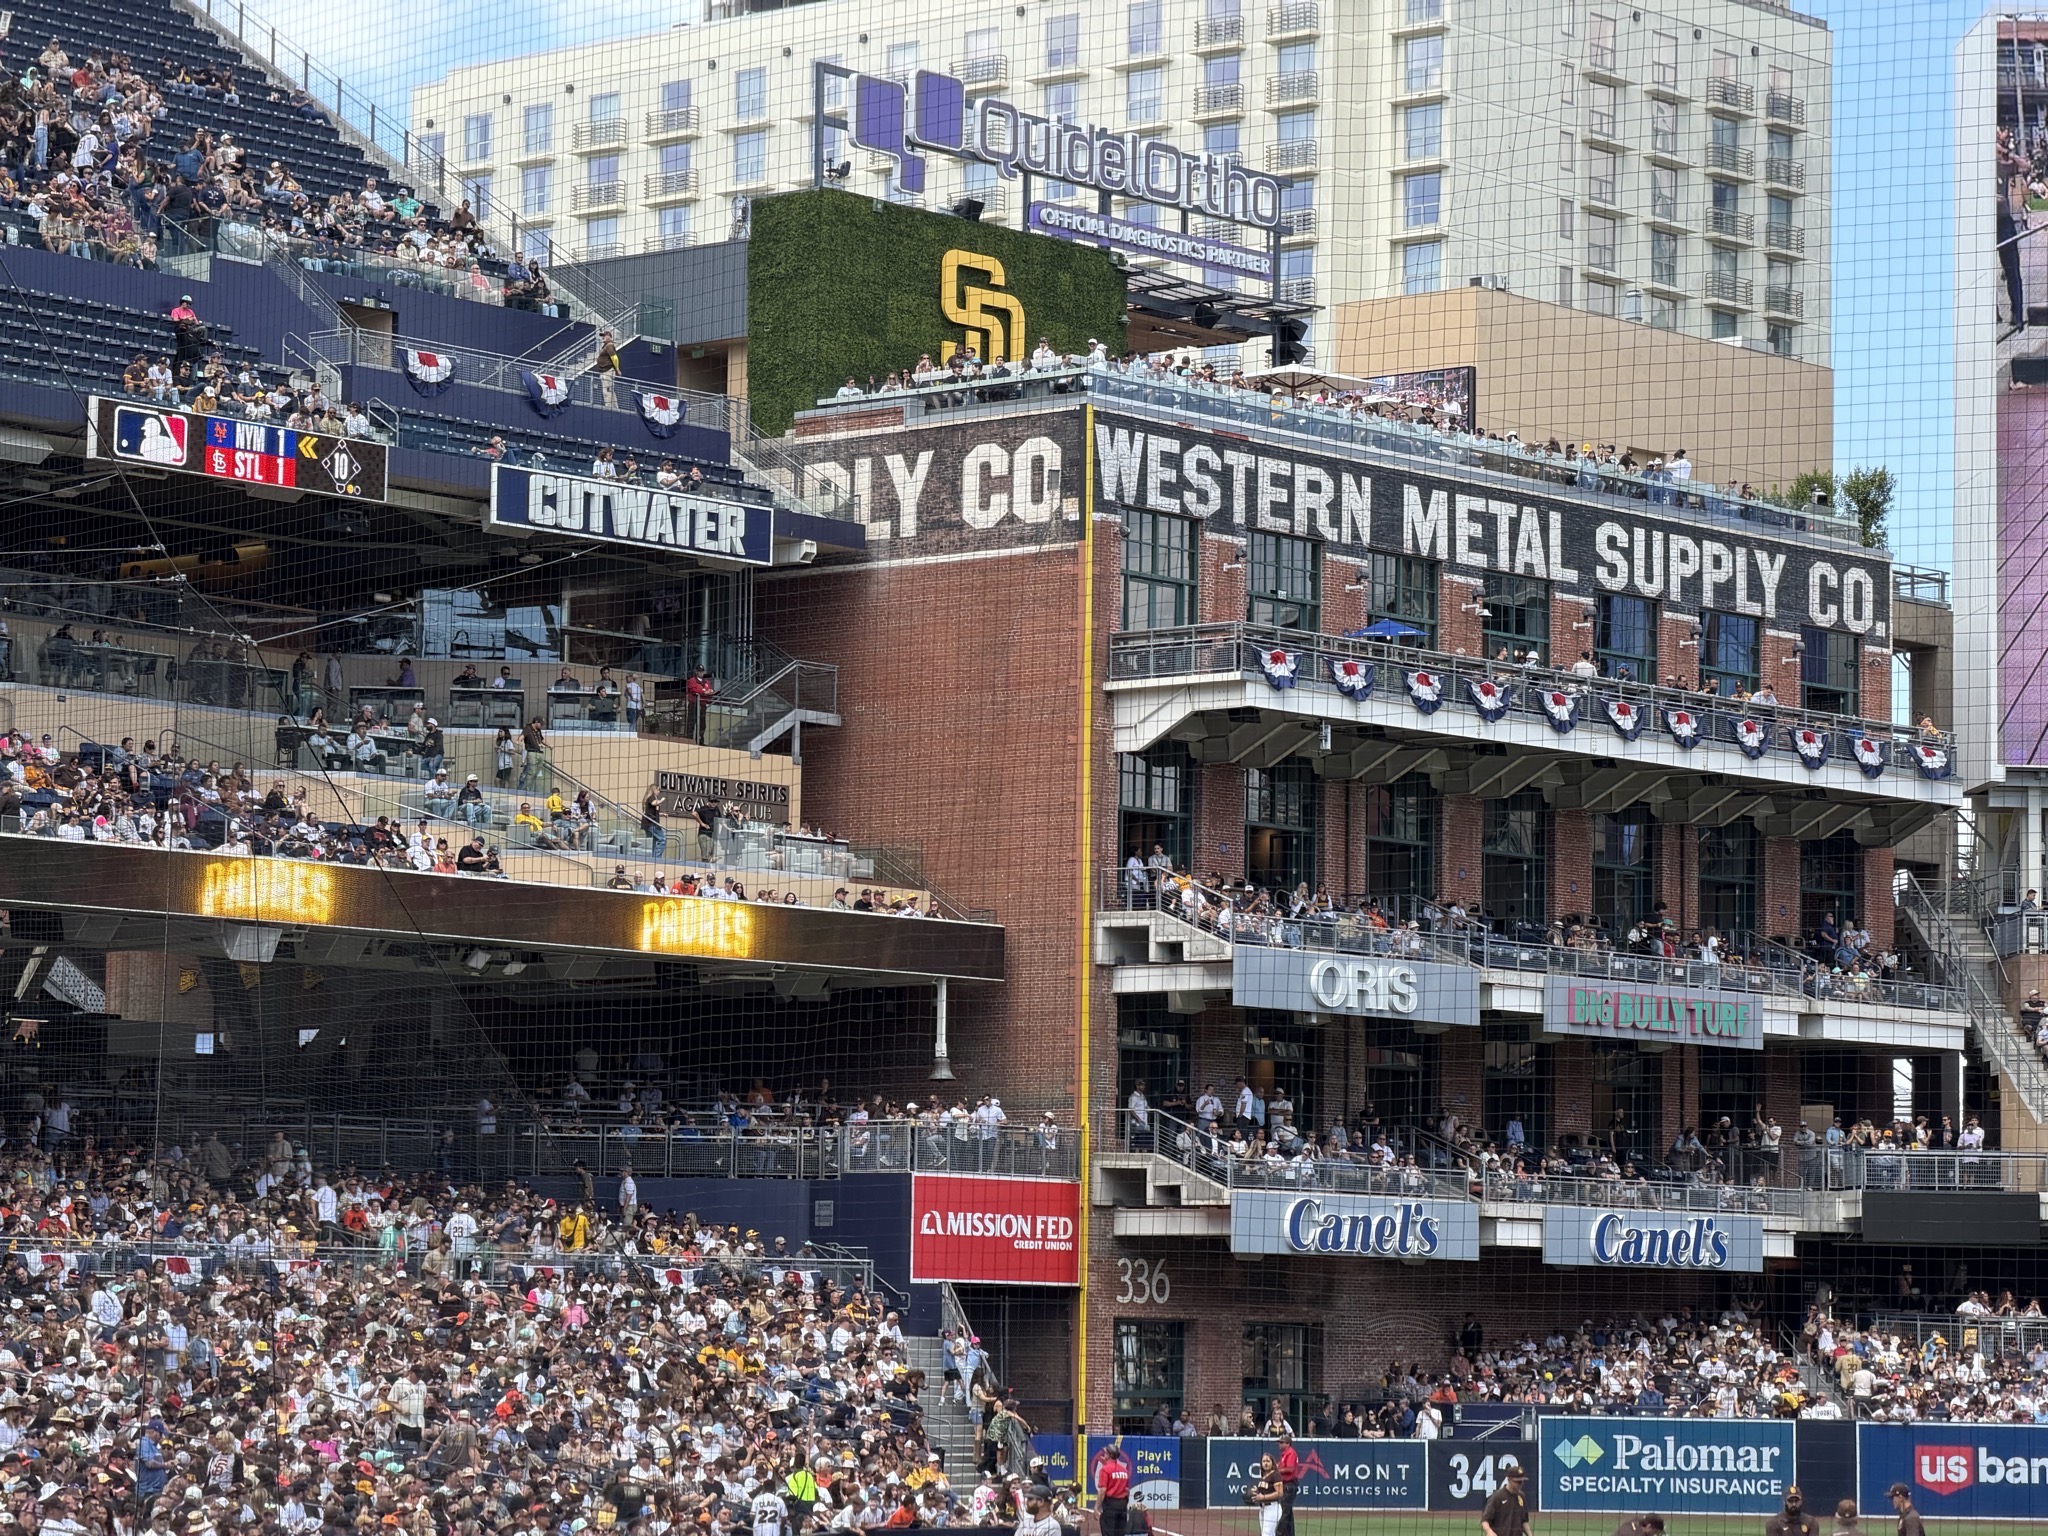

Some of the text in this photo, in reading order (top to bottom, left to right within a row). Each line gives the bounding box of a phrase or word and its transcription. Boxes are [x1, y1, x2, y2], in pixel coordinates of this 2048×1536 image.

[973, 97, 1280, 227] QuidelOrtho
[1039, 206, 1271, 274] OFFICIAL DIAGNOSTICS PARTNER
[234, 422, 286, 456] NYM 1
[233, 451, 286, 484] STL 1
[333, 452, 349, 481] 10
[527, 473, 746, 556] CUTWATER
[1093, 423, 1887, 636] WESTERN METAL SUPPLY CO.
[659, 773, 787, 802] CUTWATER SPIRITS
[203, 861, 330, 923] PADRES
[642, 898, 750, 957] PADRES
[1310, 959, 1419, 1014] ORIS
[1569, 987, 1752, 1038] BIG BULLY TURF
[947, 1211, 1074, 1240] MISSION FED
[1282, 1197, 1441, 1257] Canel's
[1590, 1212, 1732, 1269] Canel's
[1013, 1240, 1073, 1251] CREDIT UNION
[1116, 1257, 1171, 1304] 336
[1051, 1452, 1069, 1469] dig.
[1137, 1450, 1172, 1462] Play it
[1137, 1463, 1163, 1474] safe.
[1612, 1433, 1780, 1473] Palomar
[1920, 1455, 1968, 1484] us
[1147, 1493, 1172, 1501] SDGE
[1315, 1485, 1381, 1496] LOGISTICS
[1386, 1486, 1408, 1496] INC
[1559, 1475, 1783, 1496] SPECIALTY INSURANCE
[758, 1509, 778, 1524] 22
